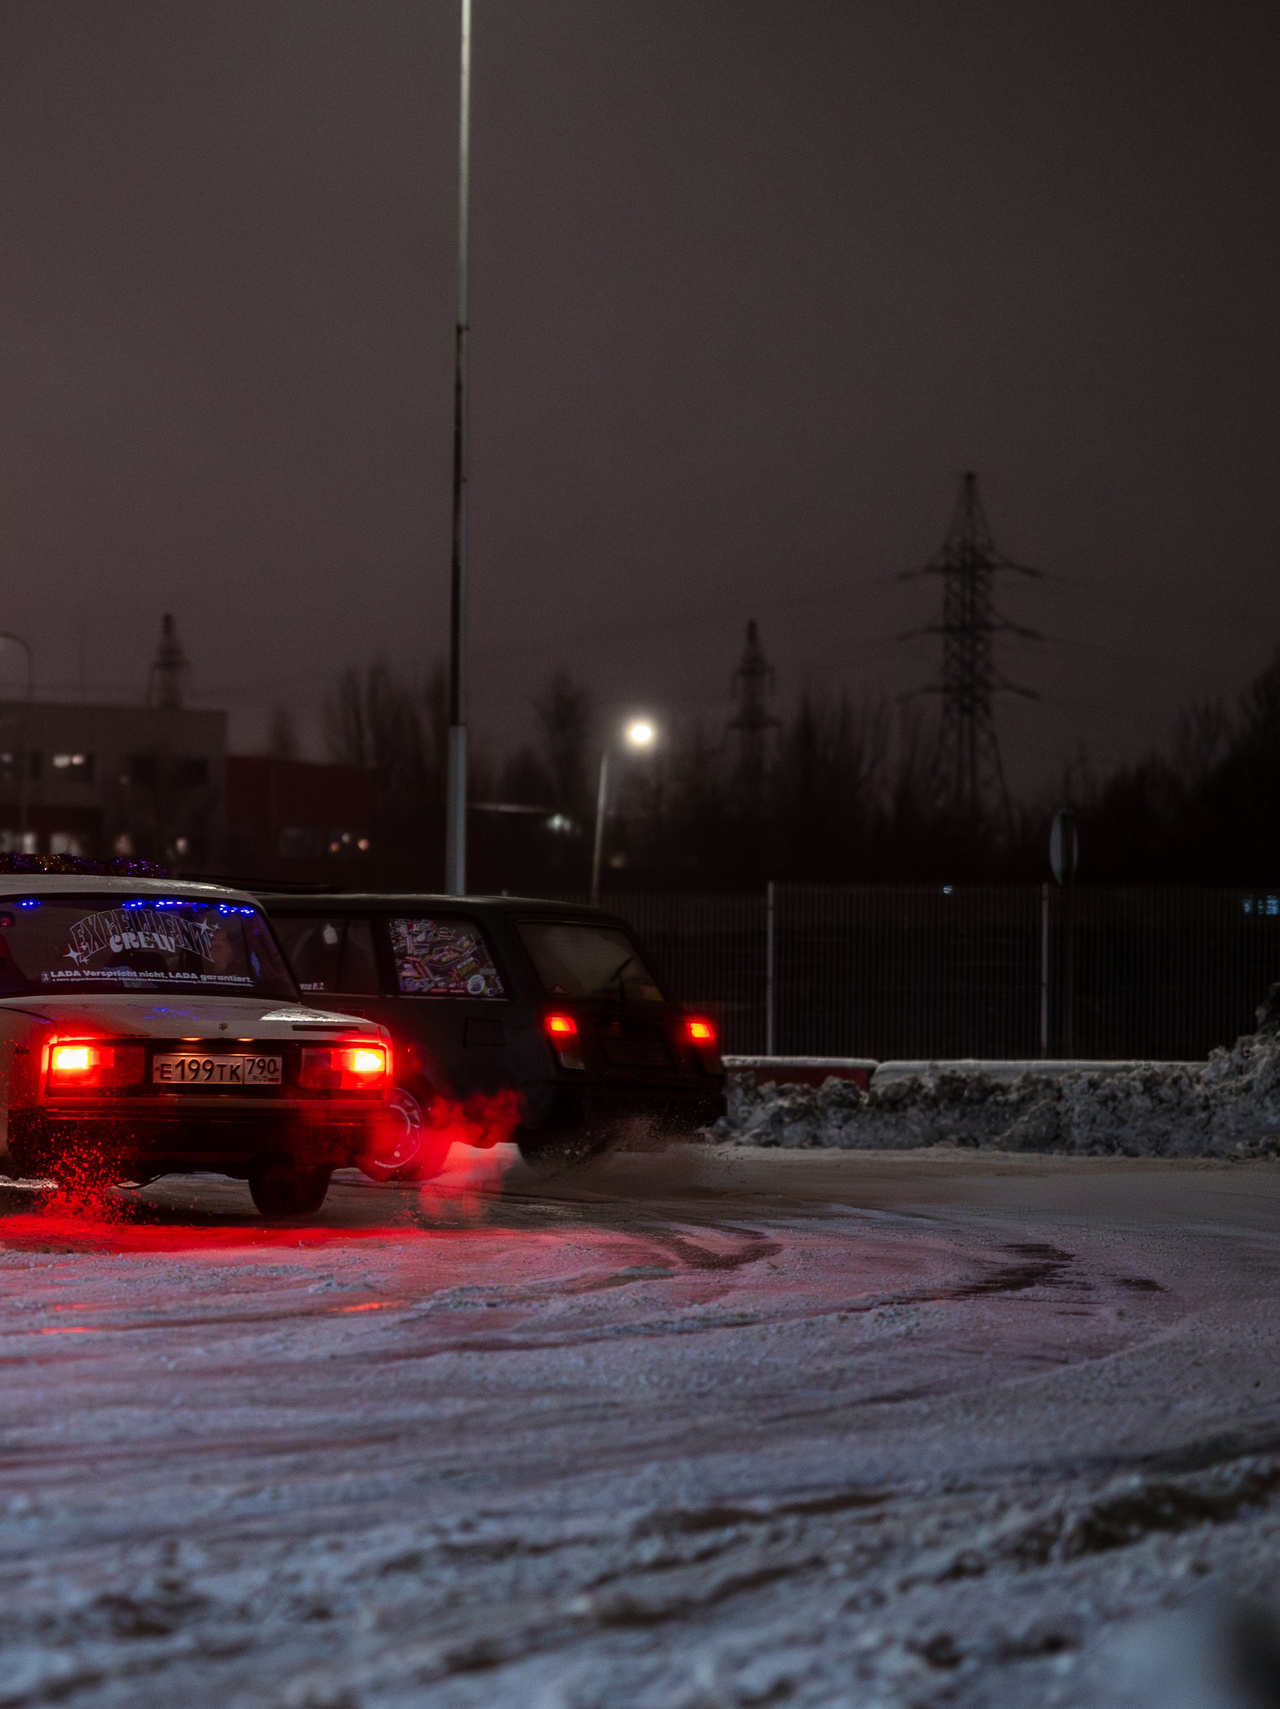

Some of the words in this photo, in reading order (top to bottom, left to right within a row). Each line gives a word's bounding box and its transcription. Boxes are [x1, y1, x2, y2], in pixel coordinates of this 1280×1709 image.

[109, 931, 176, 953] CREW
[50, 970, 81, 978] LADA
[169, 971, 199, 979] LADA
[246, 1058, 277, 1075] 790
